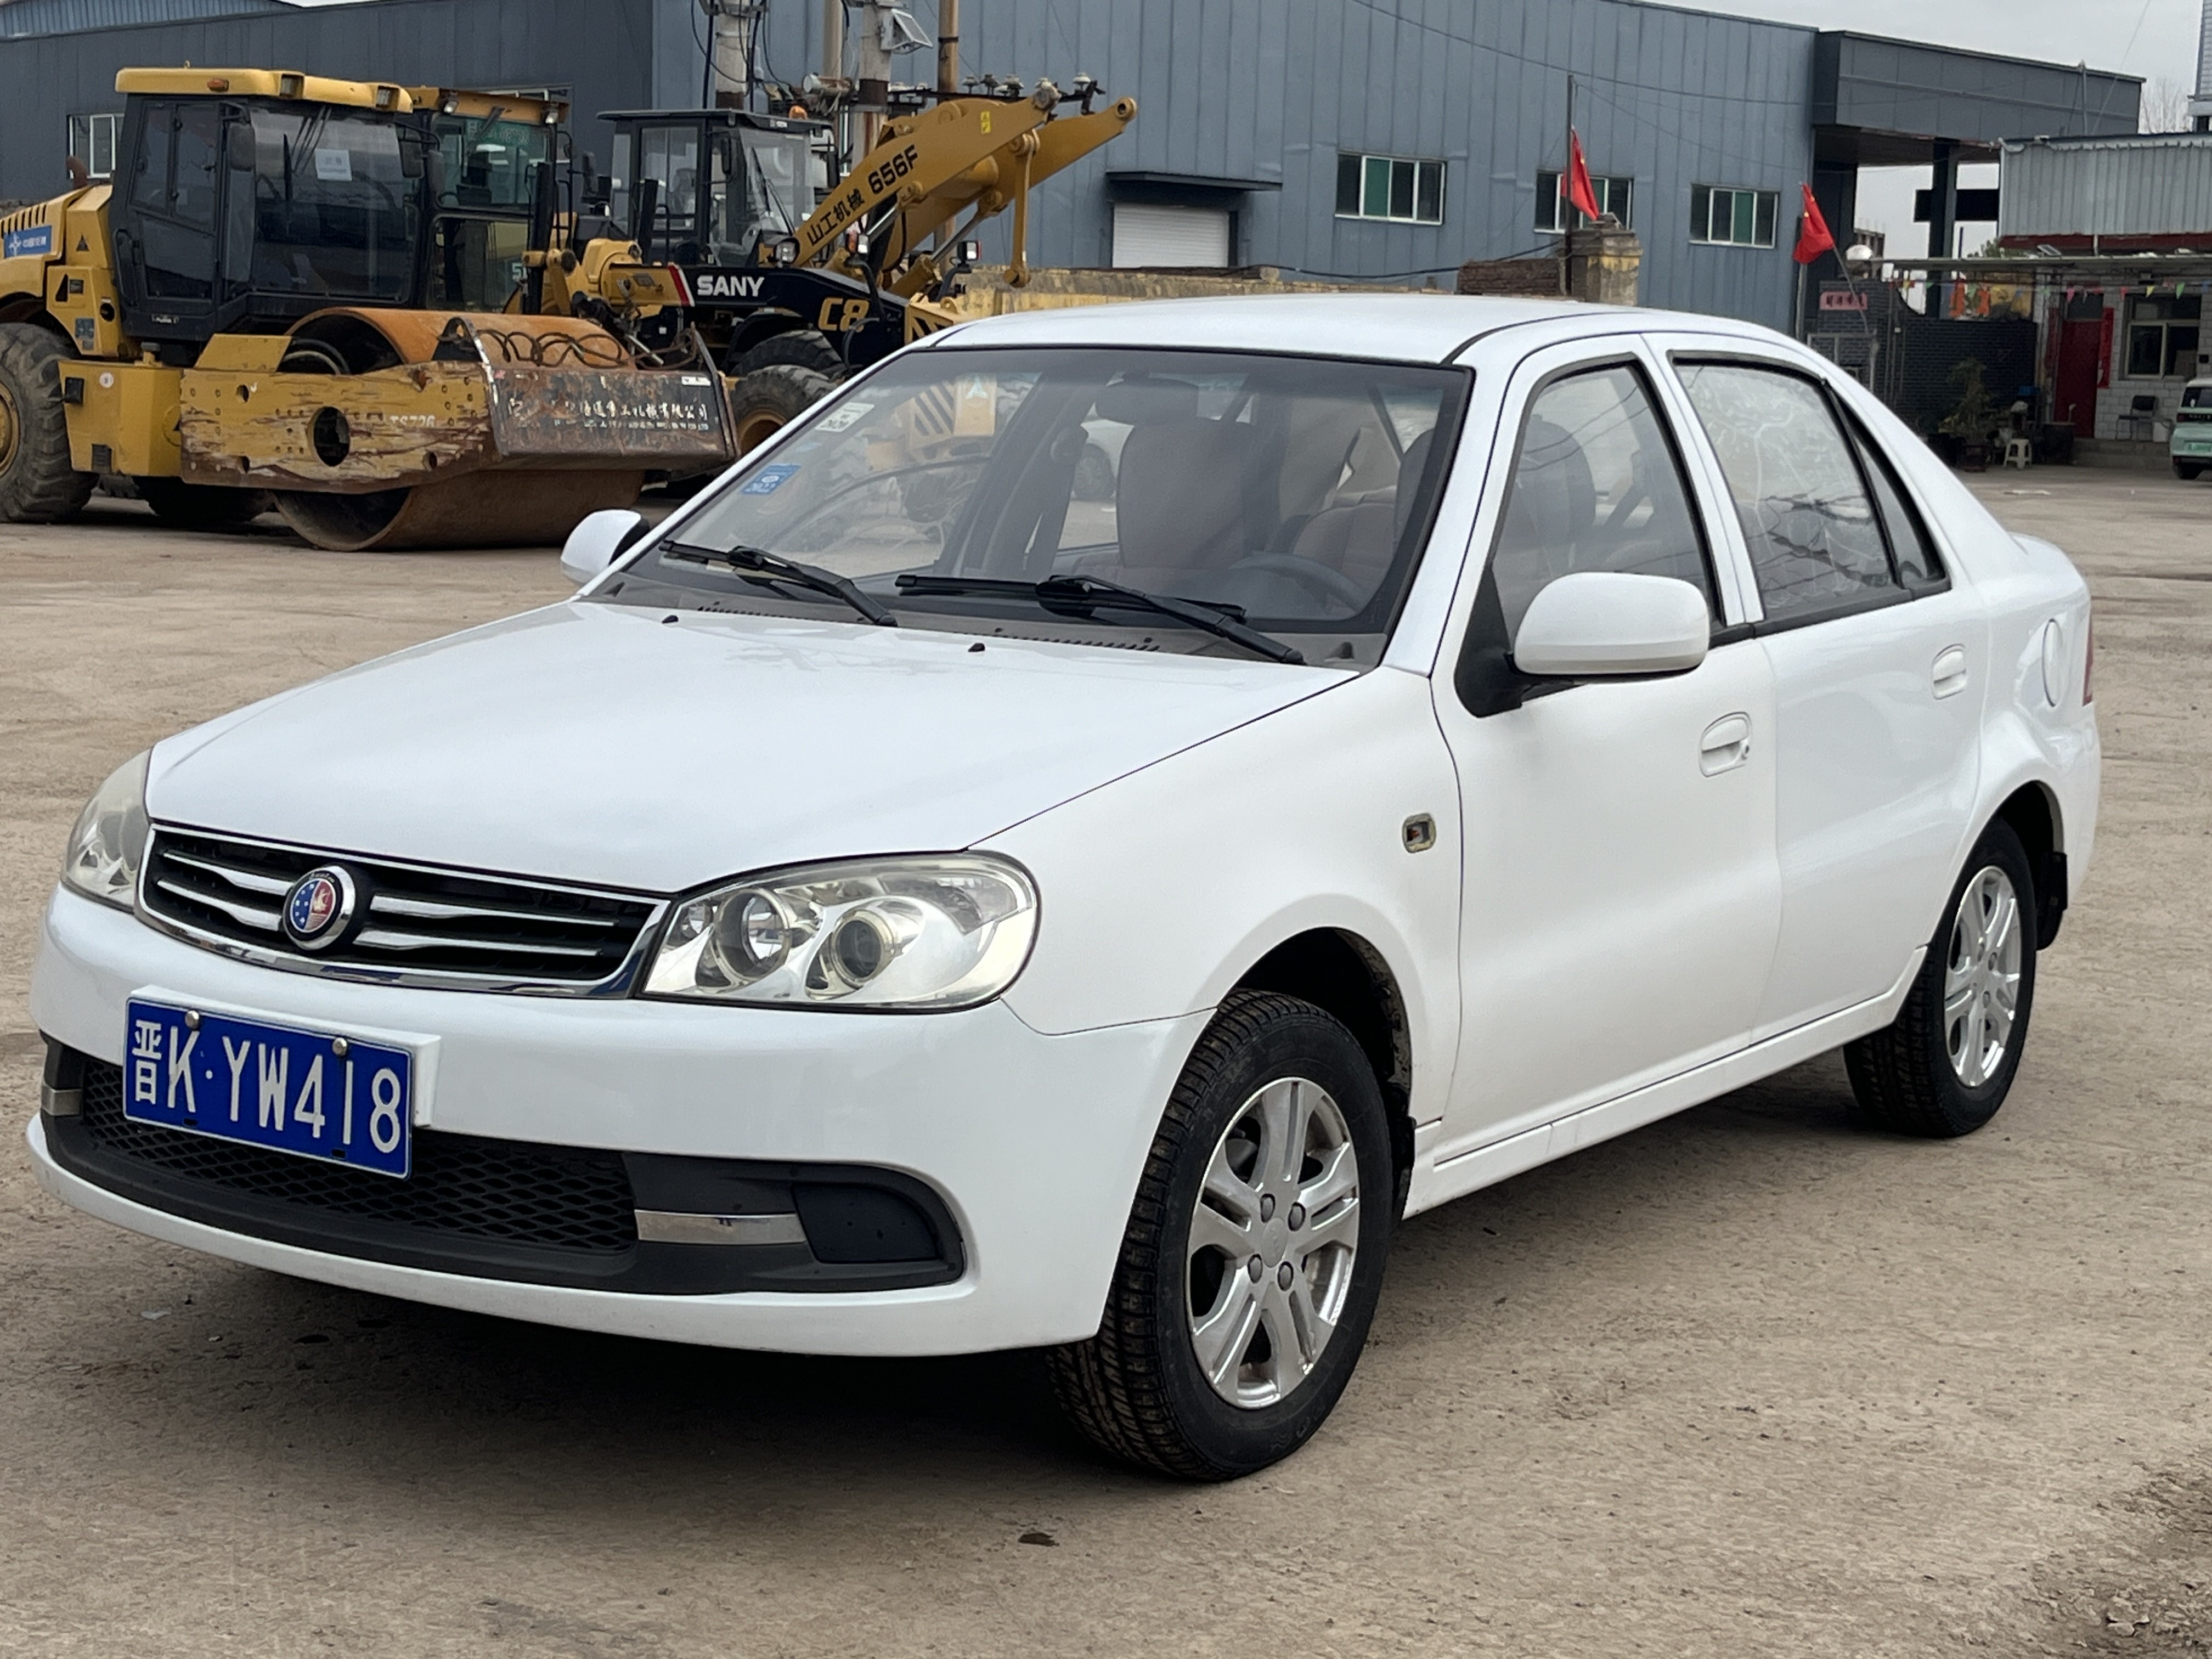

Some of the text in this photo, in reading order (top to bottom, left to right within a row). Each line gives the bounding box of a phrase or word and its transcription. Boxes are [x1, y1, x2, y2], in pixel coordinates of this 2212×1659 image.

[806, 144, 918, 246] 山工机械 656F
[697, 275, 765, 297] SANY
[818, 297, 870, 332] C8
